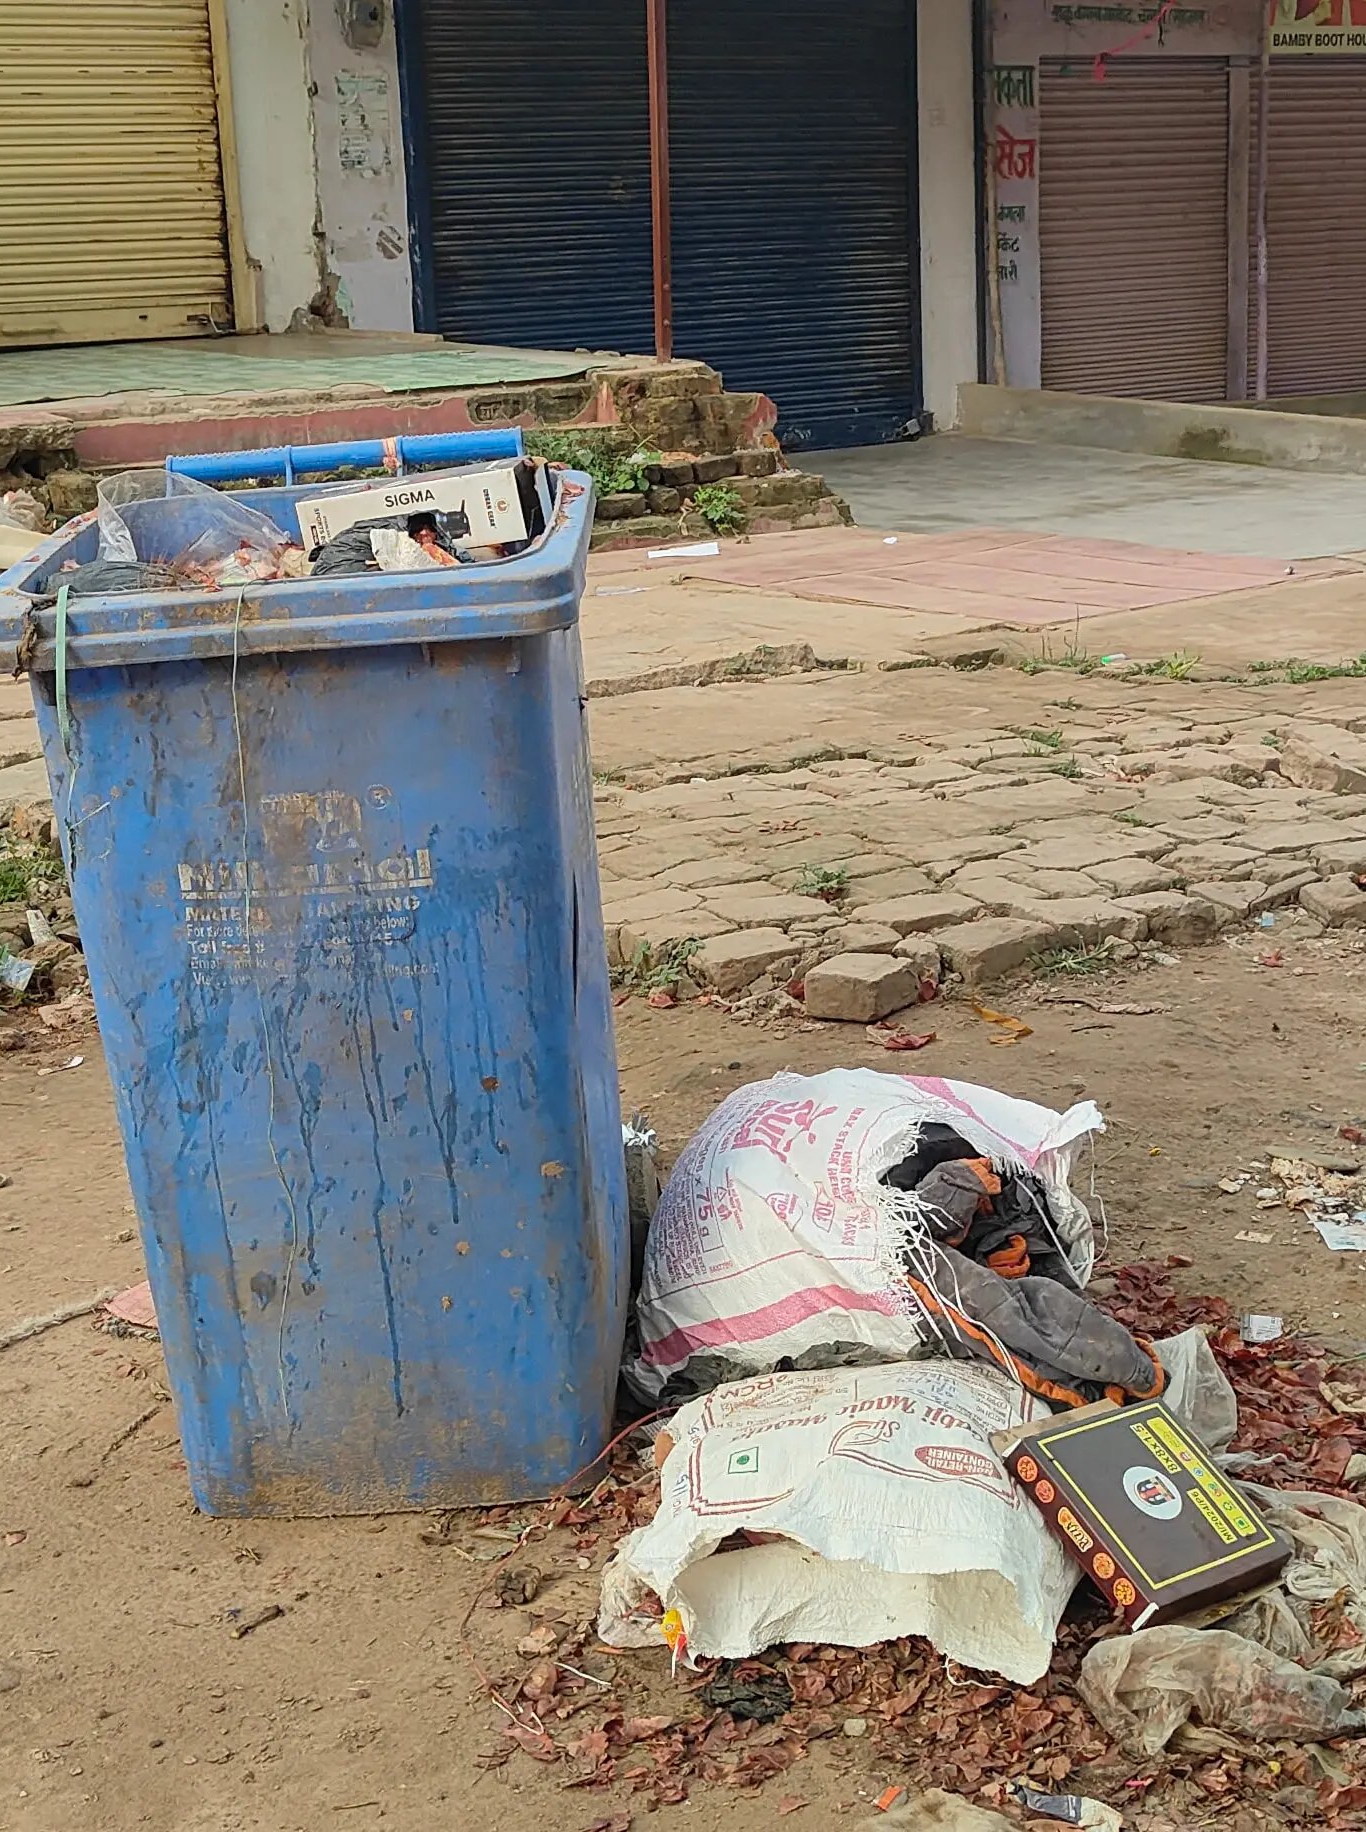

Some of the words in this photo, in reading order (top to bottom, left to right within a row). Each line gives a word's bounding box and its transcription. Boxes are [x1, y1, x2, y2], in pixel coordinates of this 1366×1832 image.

[1273, 33, 1313, 47] BAMBY
[1315, 33, 1345, 47] BOOT
[383, 487, 436, 509] SIGMA
[696, 1187, 713, 1221] 75
[926, 1456, 994, 1476] NON-RETAIL
[927, 1447, 994, 1468] CONTAINER
